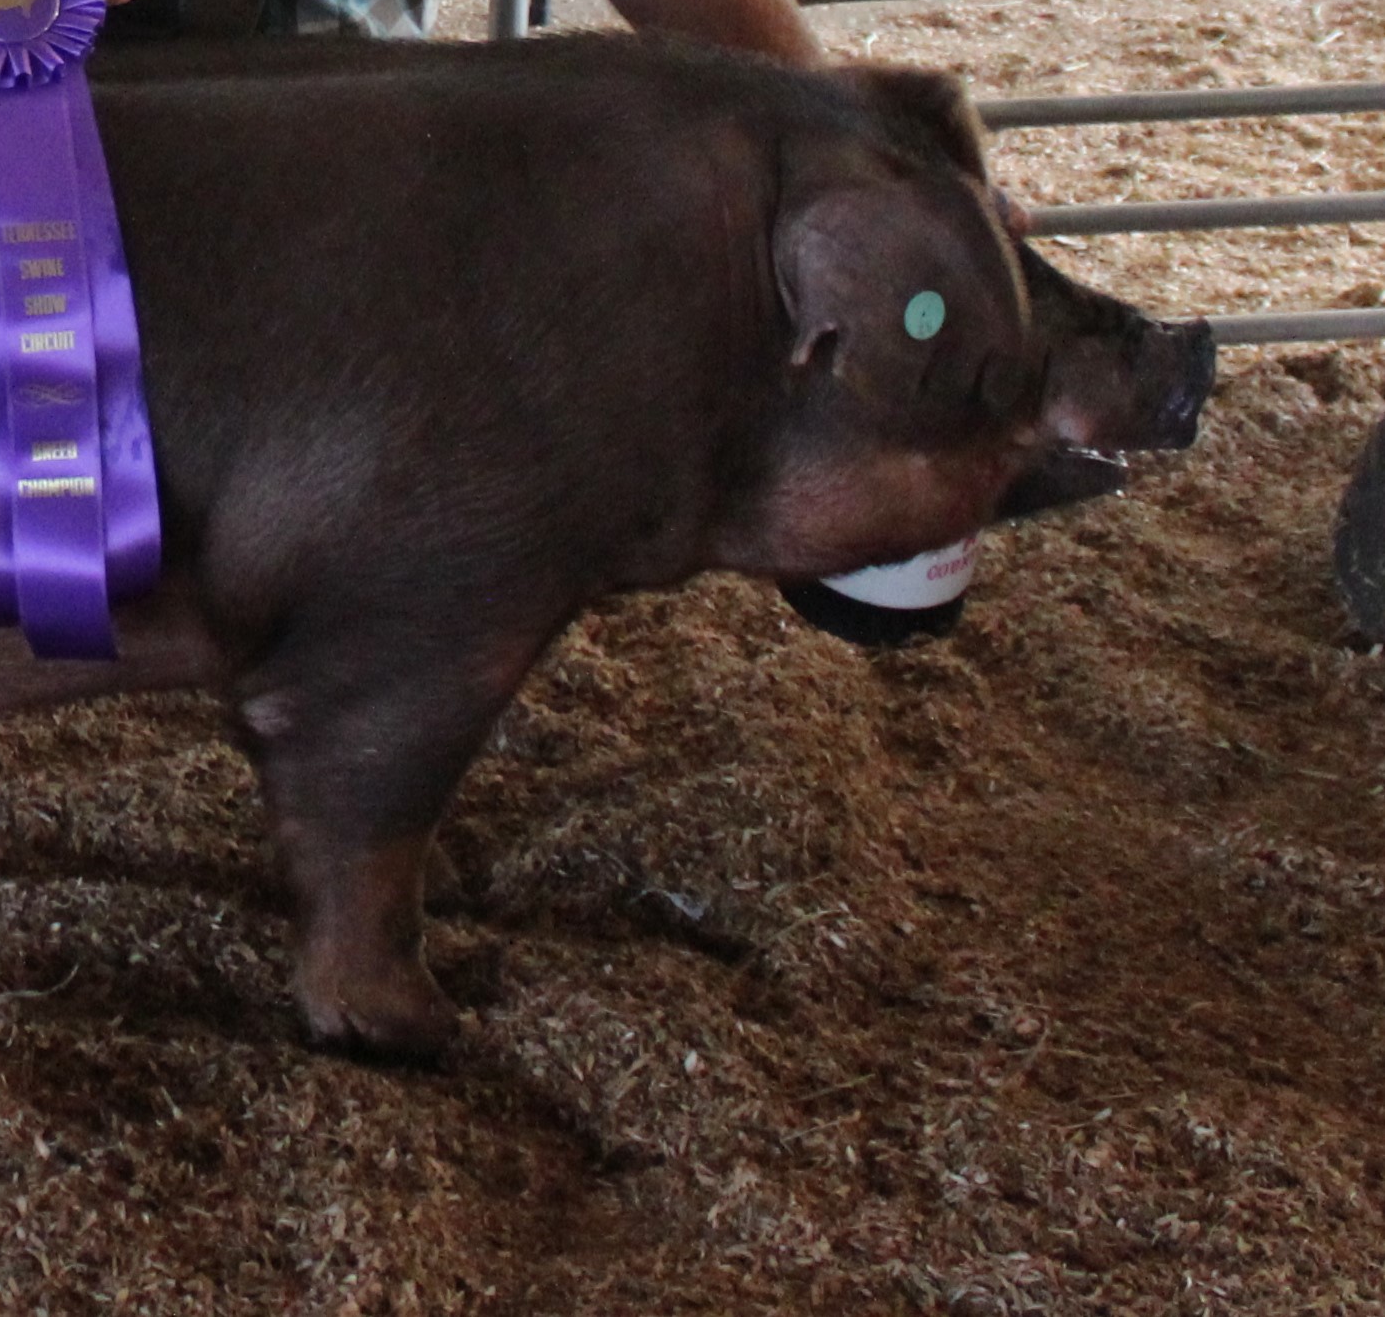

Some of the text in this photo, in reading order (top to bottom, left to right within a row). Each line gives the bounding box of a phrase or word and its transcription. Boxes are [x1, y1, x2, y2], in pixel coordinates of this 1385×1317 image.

[20, 258, 65, 280] SWINE
[24, 294, 67, 316] SHOW
[21, 330, 76, 354] CIRCUIT
